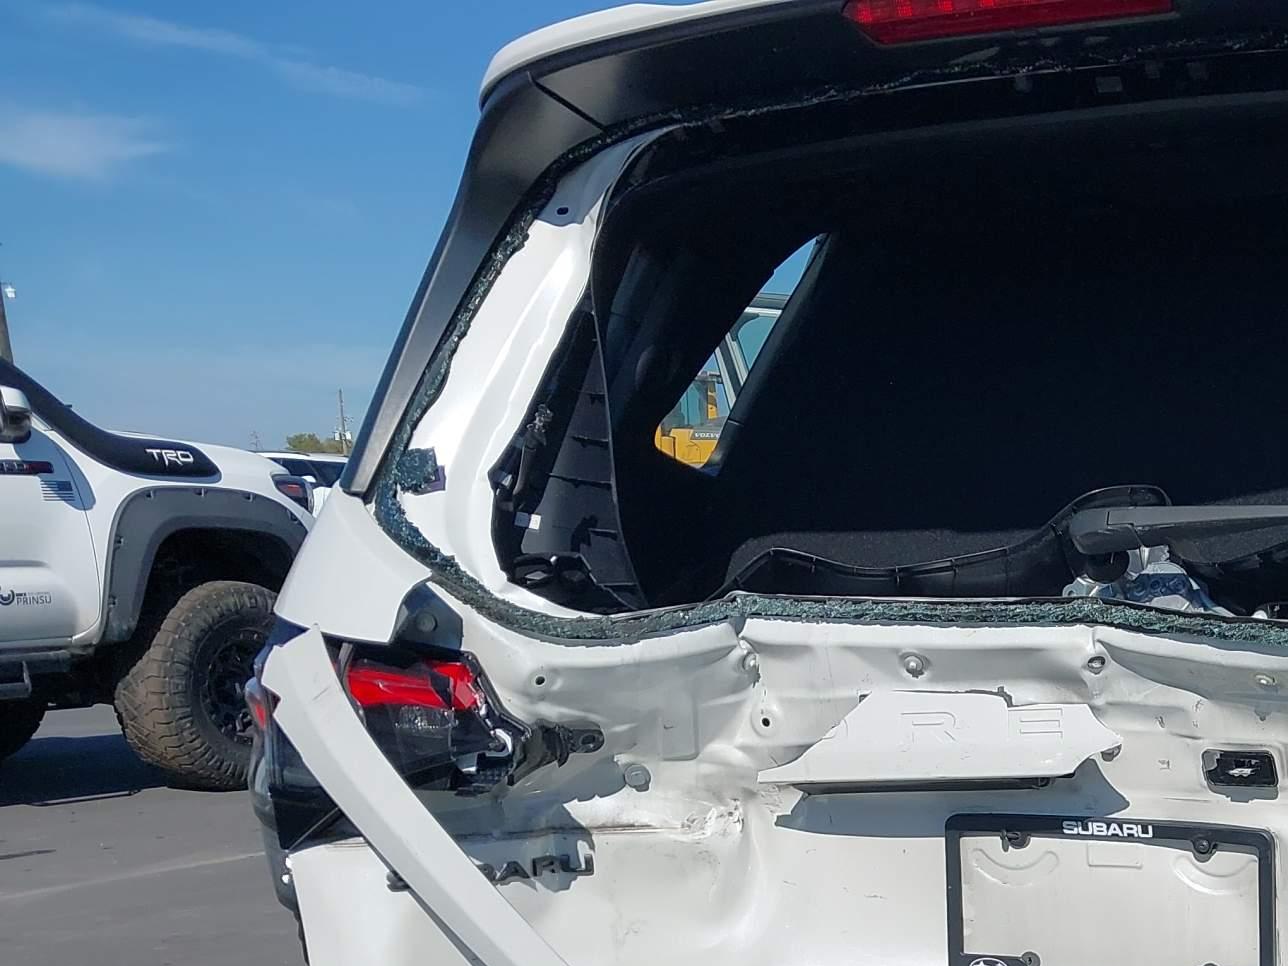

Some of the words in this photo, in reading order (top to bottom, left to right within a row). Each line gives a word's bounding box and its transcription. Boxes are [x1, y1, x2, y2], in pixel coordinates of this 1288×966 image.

[145, 448, 194, 466] TRD
[16, 595, 52, 606] PRINSU
[1062, 820, 1153, 838] SUBARU
